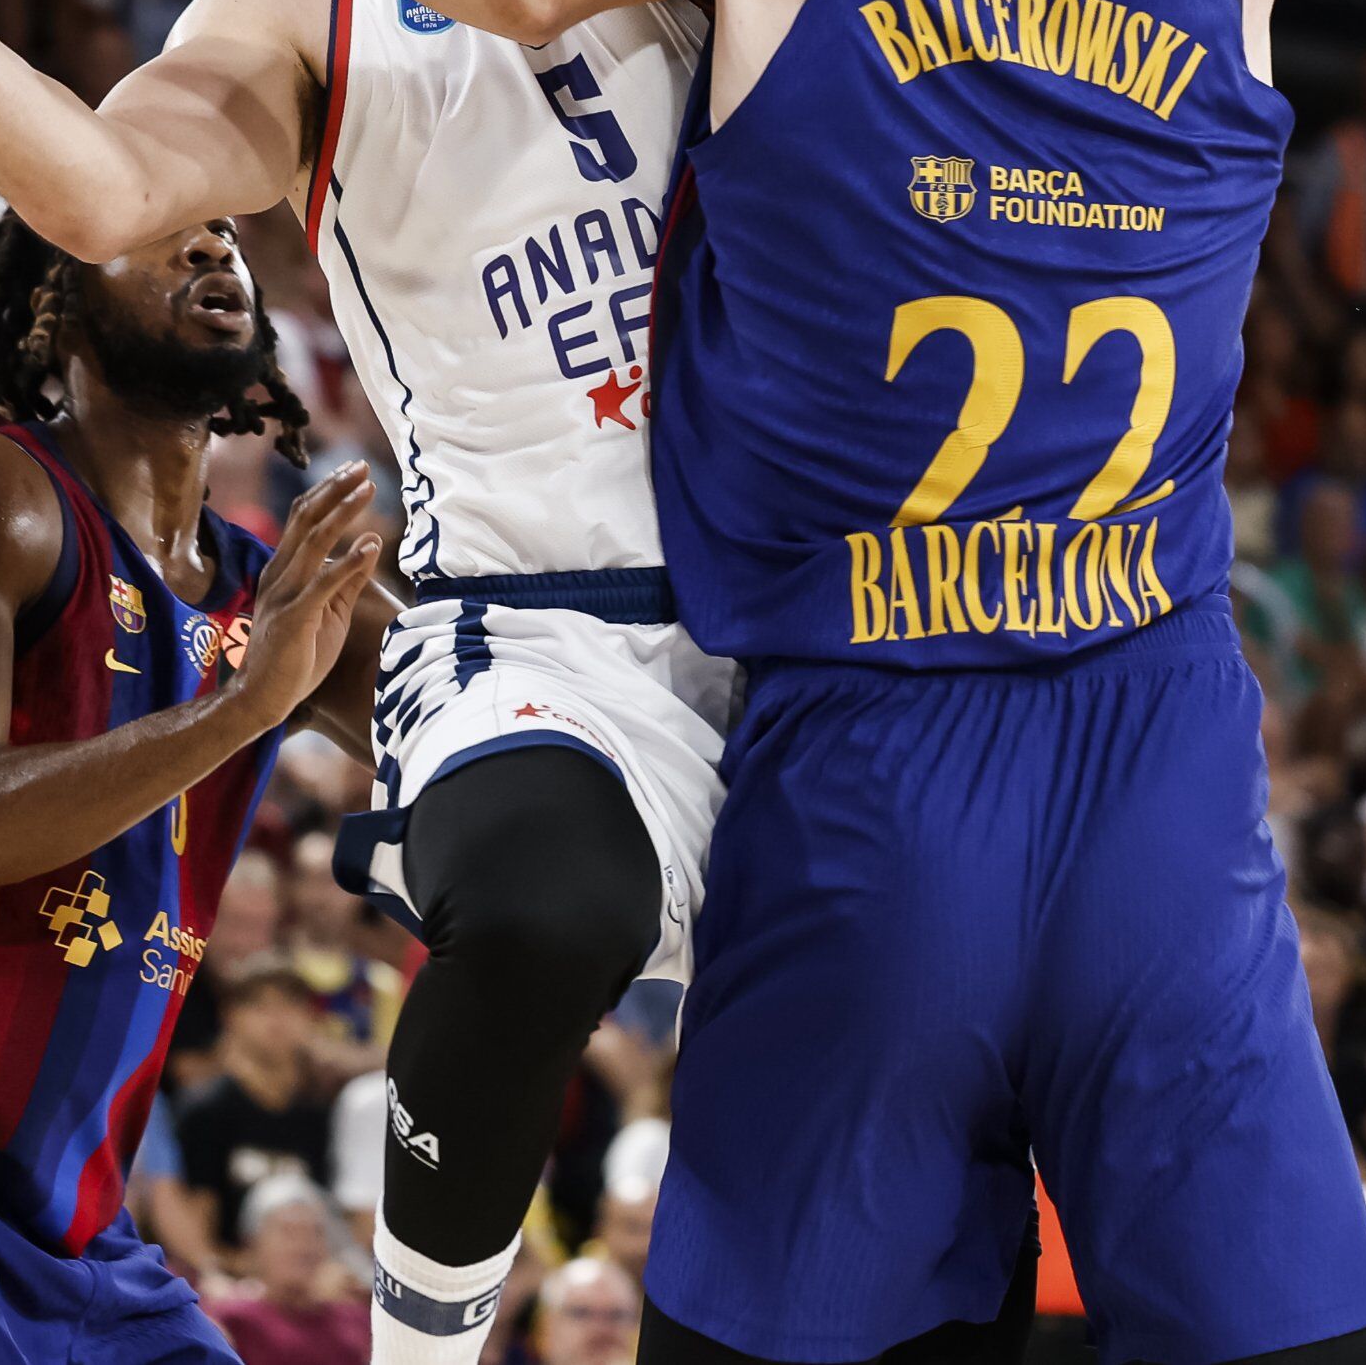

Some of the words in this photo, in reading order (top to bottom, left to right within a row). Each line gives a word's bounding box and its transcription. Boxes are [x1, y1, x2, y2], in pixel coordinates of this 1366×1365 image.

[406, 5, 439, 19] ANAD
[414, 13, 446, 23] EFES
[533, 51, 638, 184] 5
[929, 183, 956, 193] FCB
[989, 165, 1085, 200] BARÇA
[989, 195, 1166, 232] FOUNDATION
[482, 197, 664, 341] ANAD
[547, 281, 654, 380] EF
[884, 294, 1177, 529] 22
[844, 515, 1174, 645] BARCELONA
[143, 910, 208, 963] Assis
